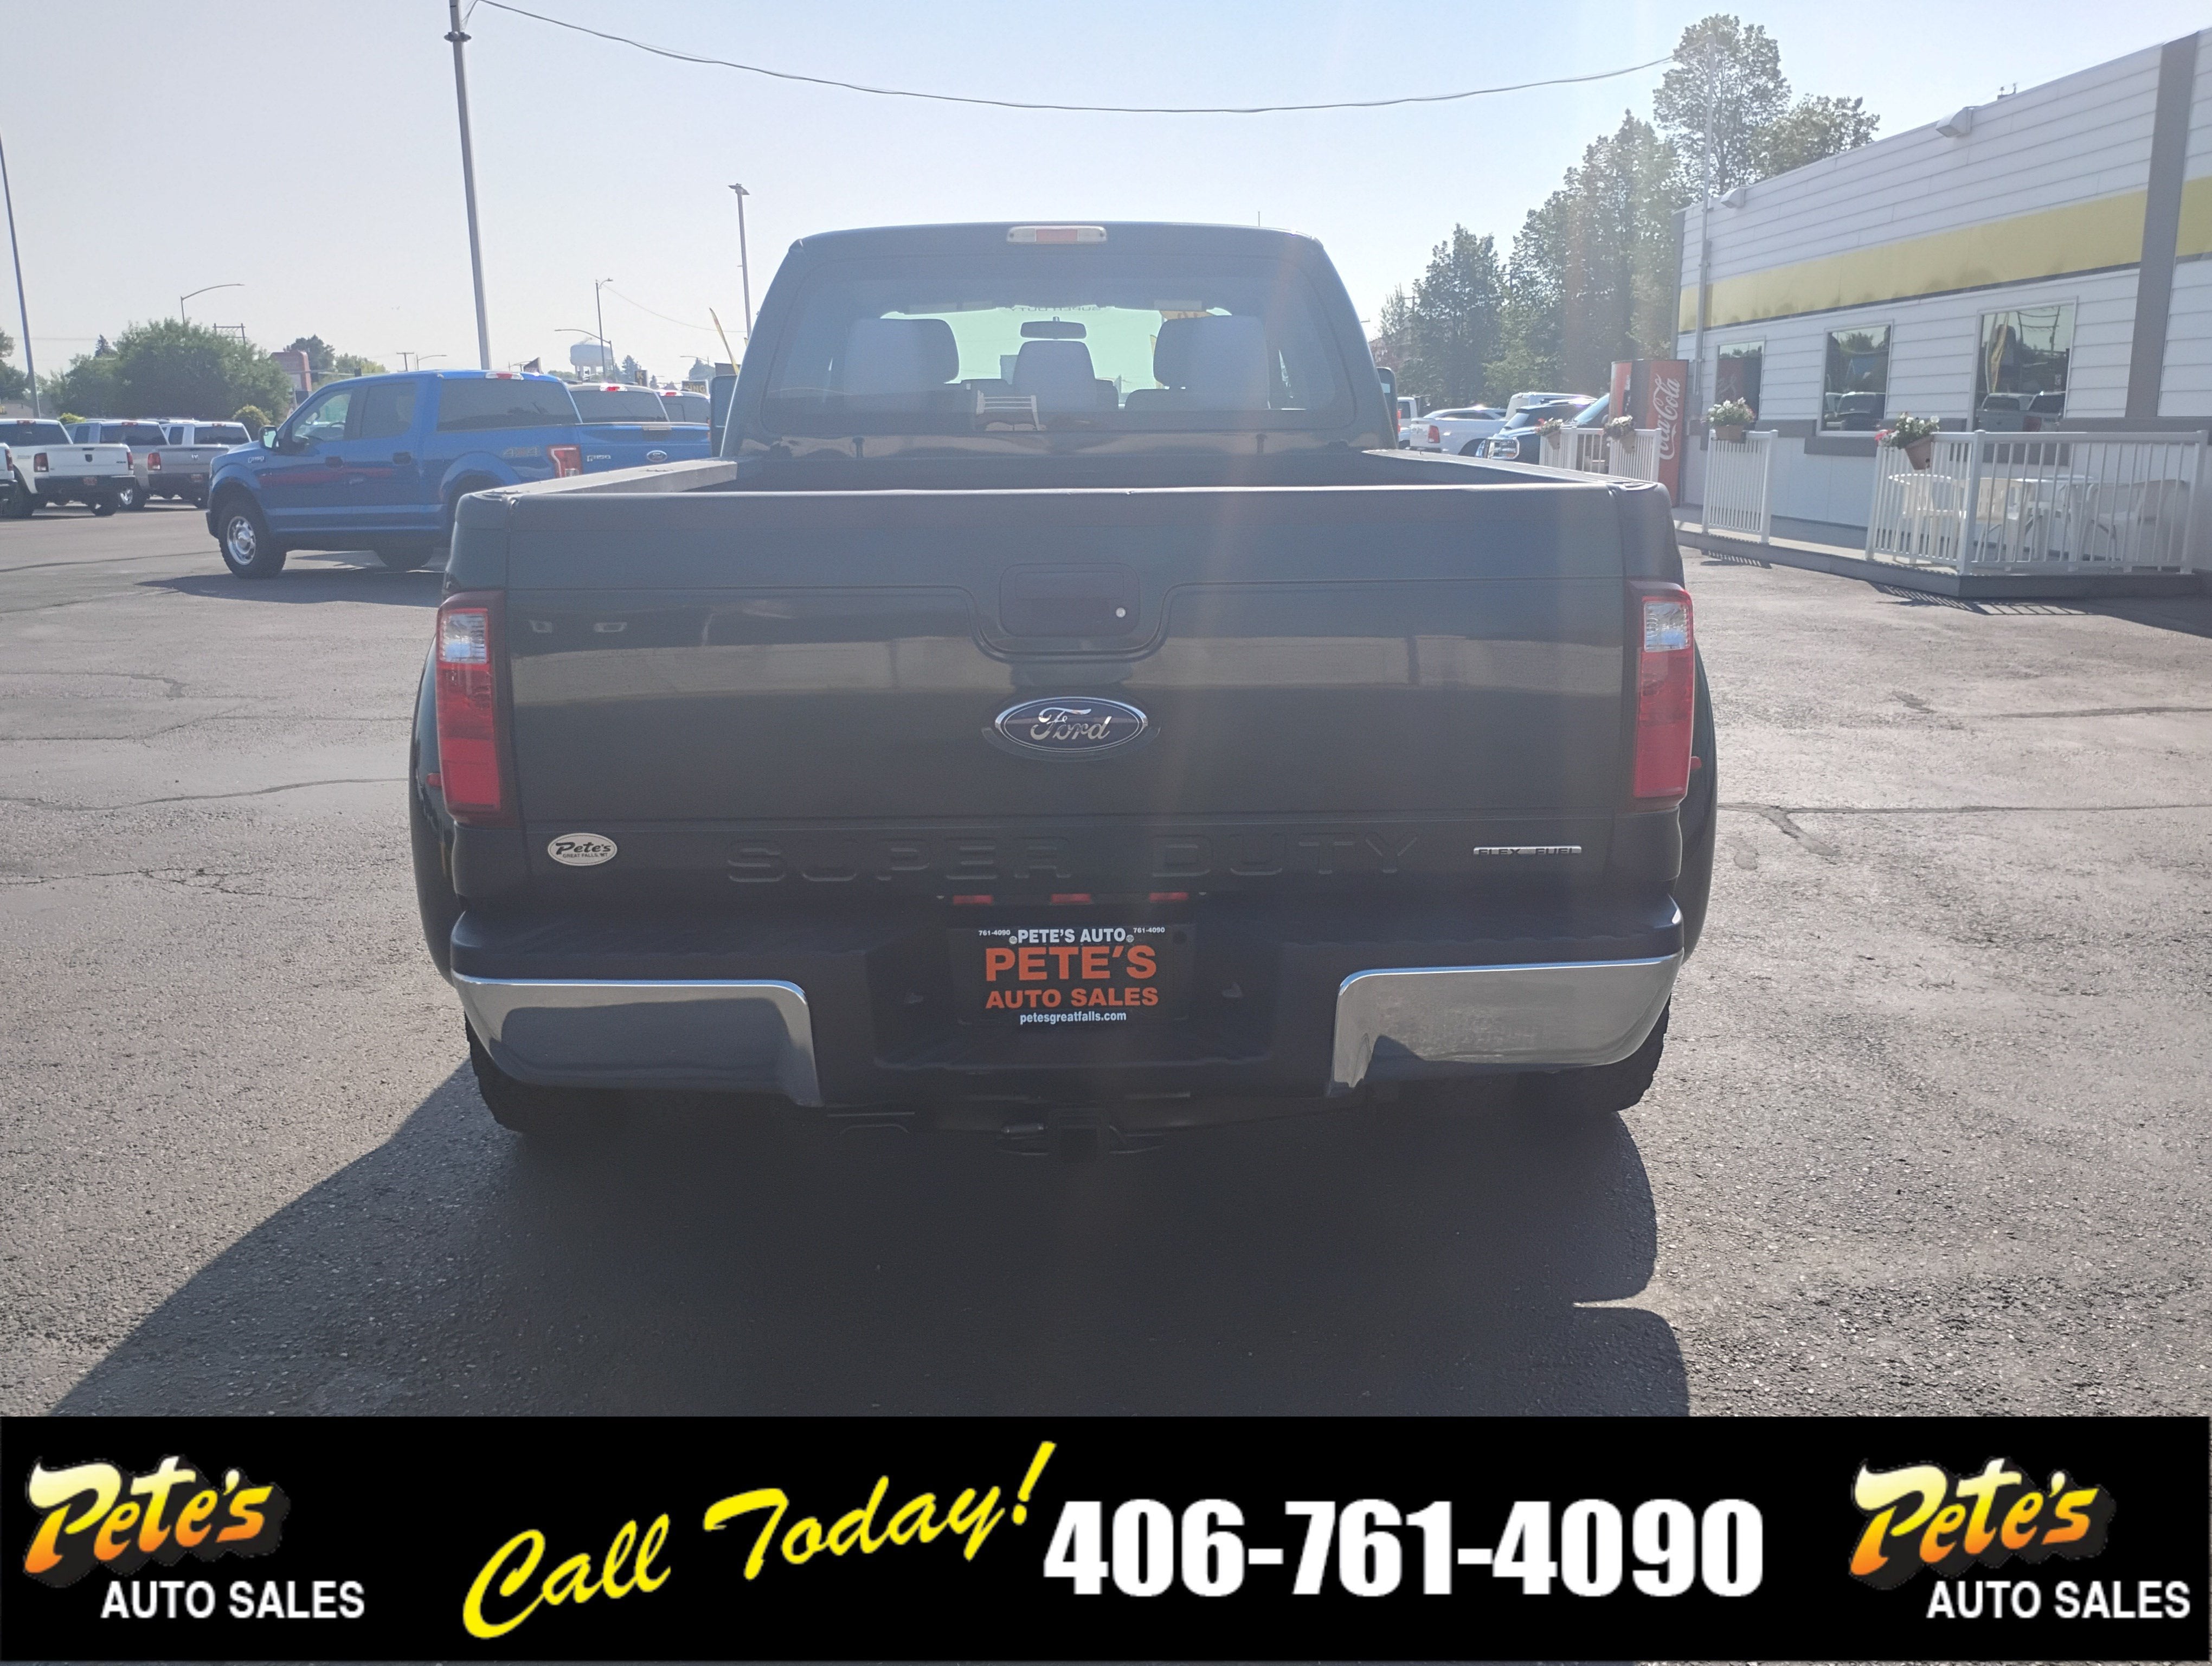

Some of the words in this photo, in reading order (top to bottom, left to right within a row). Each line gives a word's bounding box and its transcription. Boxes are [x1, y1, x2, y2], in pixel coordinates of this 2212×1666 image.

[1031, 707, 1112, 740] Ford
[555, 842, 612, 855] Pete's
[728, 837, 1071, 882] SUPER
[1151, 832, 1418, 878] DUTY
[1478, 848, 1521, 856] FLEX
[1535, 847, 1578, 855] FUEL
[1018, 928, 1075, 944] PETE'S
[1080, 927, 1126, 943] AUTO
[986, 945, 1156, 981] PETE'S
[986, 989, 1061, 1009] AUTO
[1071, 987, 1159, 1007] SALES
[1019, 1011, 1127, 1025] petesgreatfalls.com
